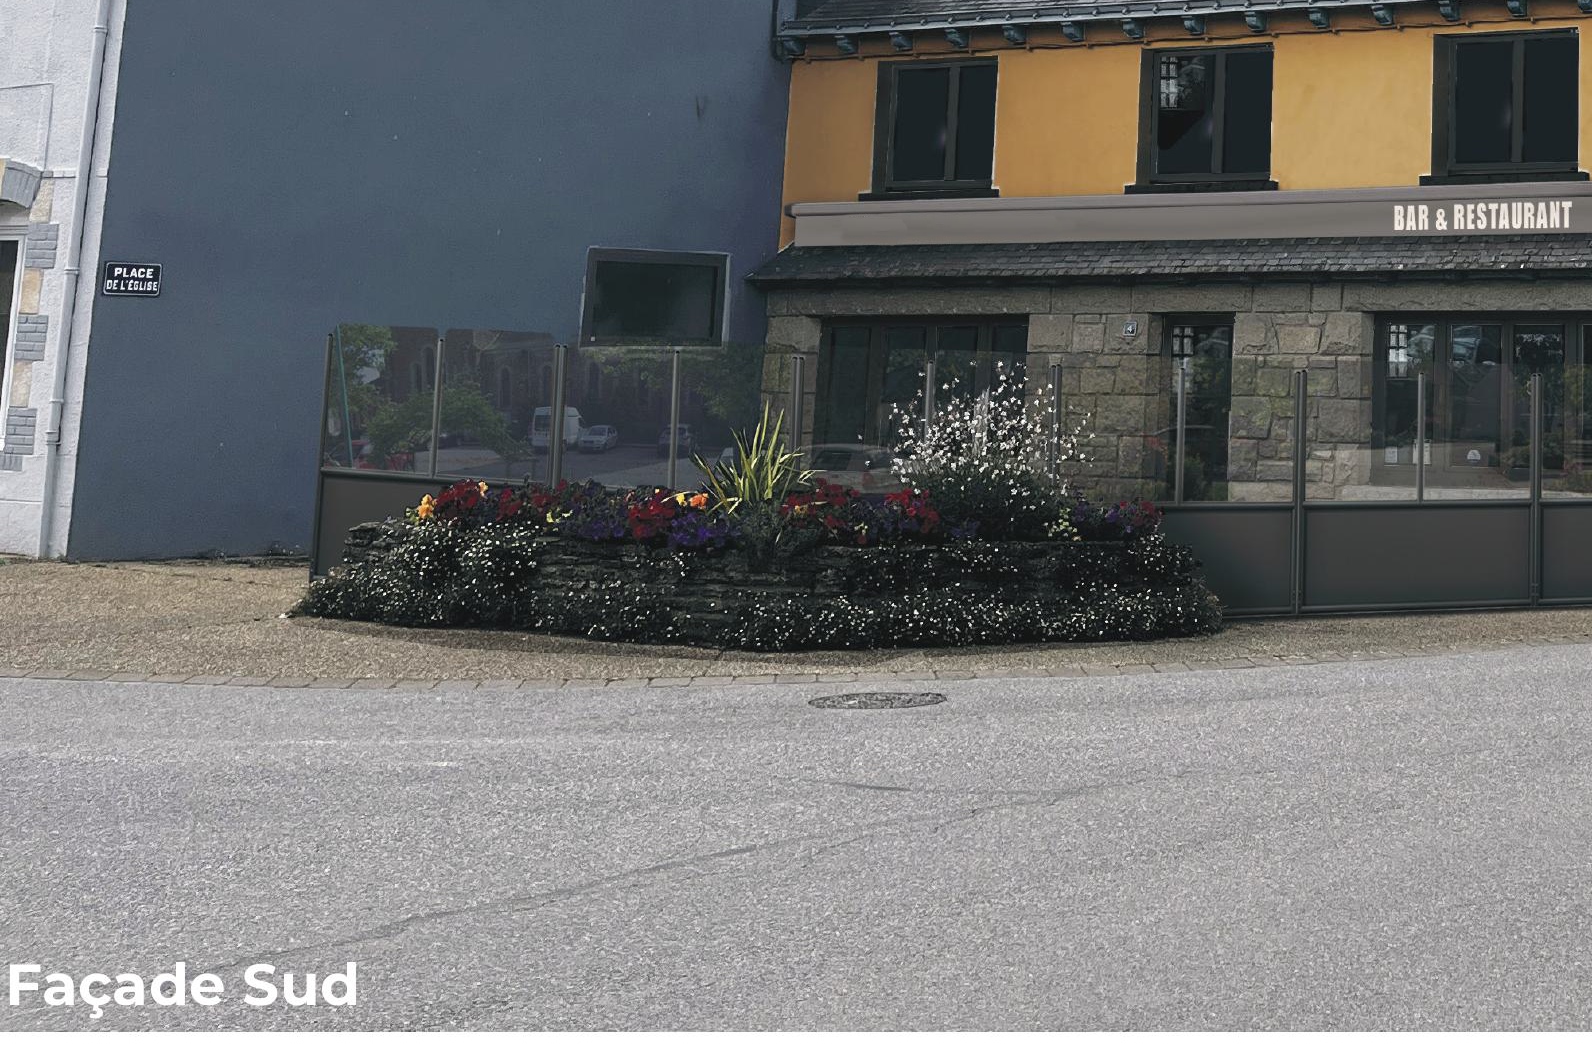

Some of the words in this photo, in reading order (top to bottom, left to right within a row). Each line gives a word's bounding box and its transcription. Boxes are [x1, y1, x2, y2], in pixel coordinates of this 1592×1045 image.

[1393, 204, 1429, 231] BAR
[1435, 208, 1448, 231] &
[1453, 201, 1573, 230] RESTAURANT
[114, 267, 154, 279] PLACE
[106, 279, 119, 290] DE
[120, 279, 158, 291] L'ÉGLISE
